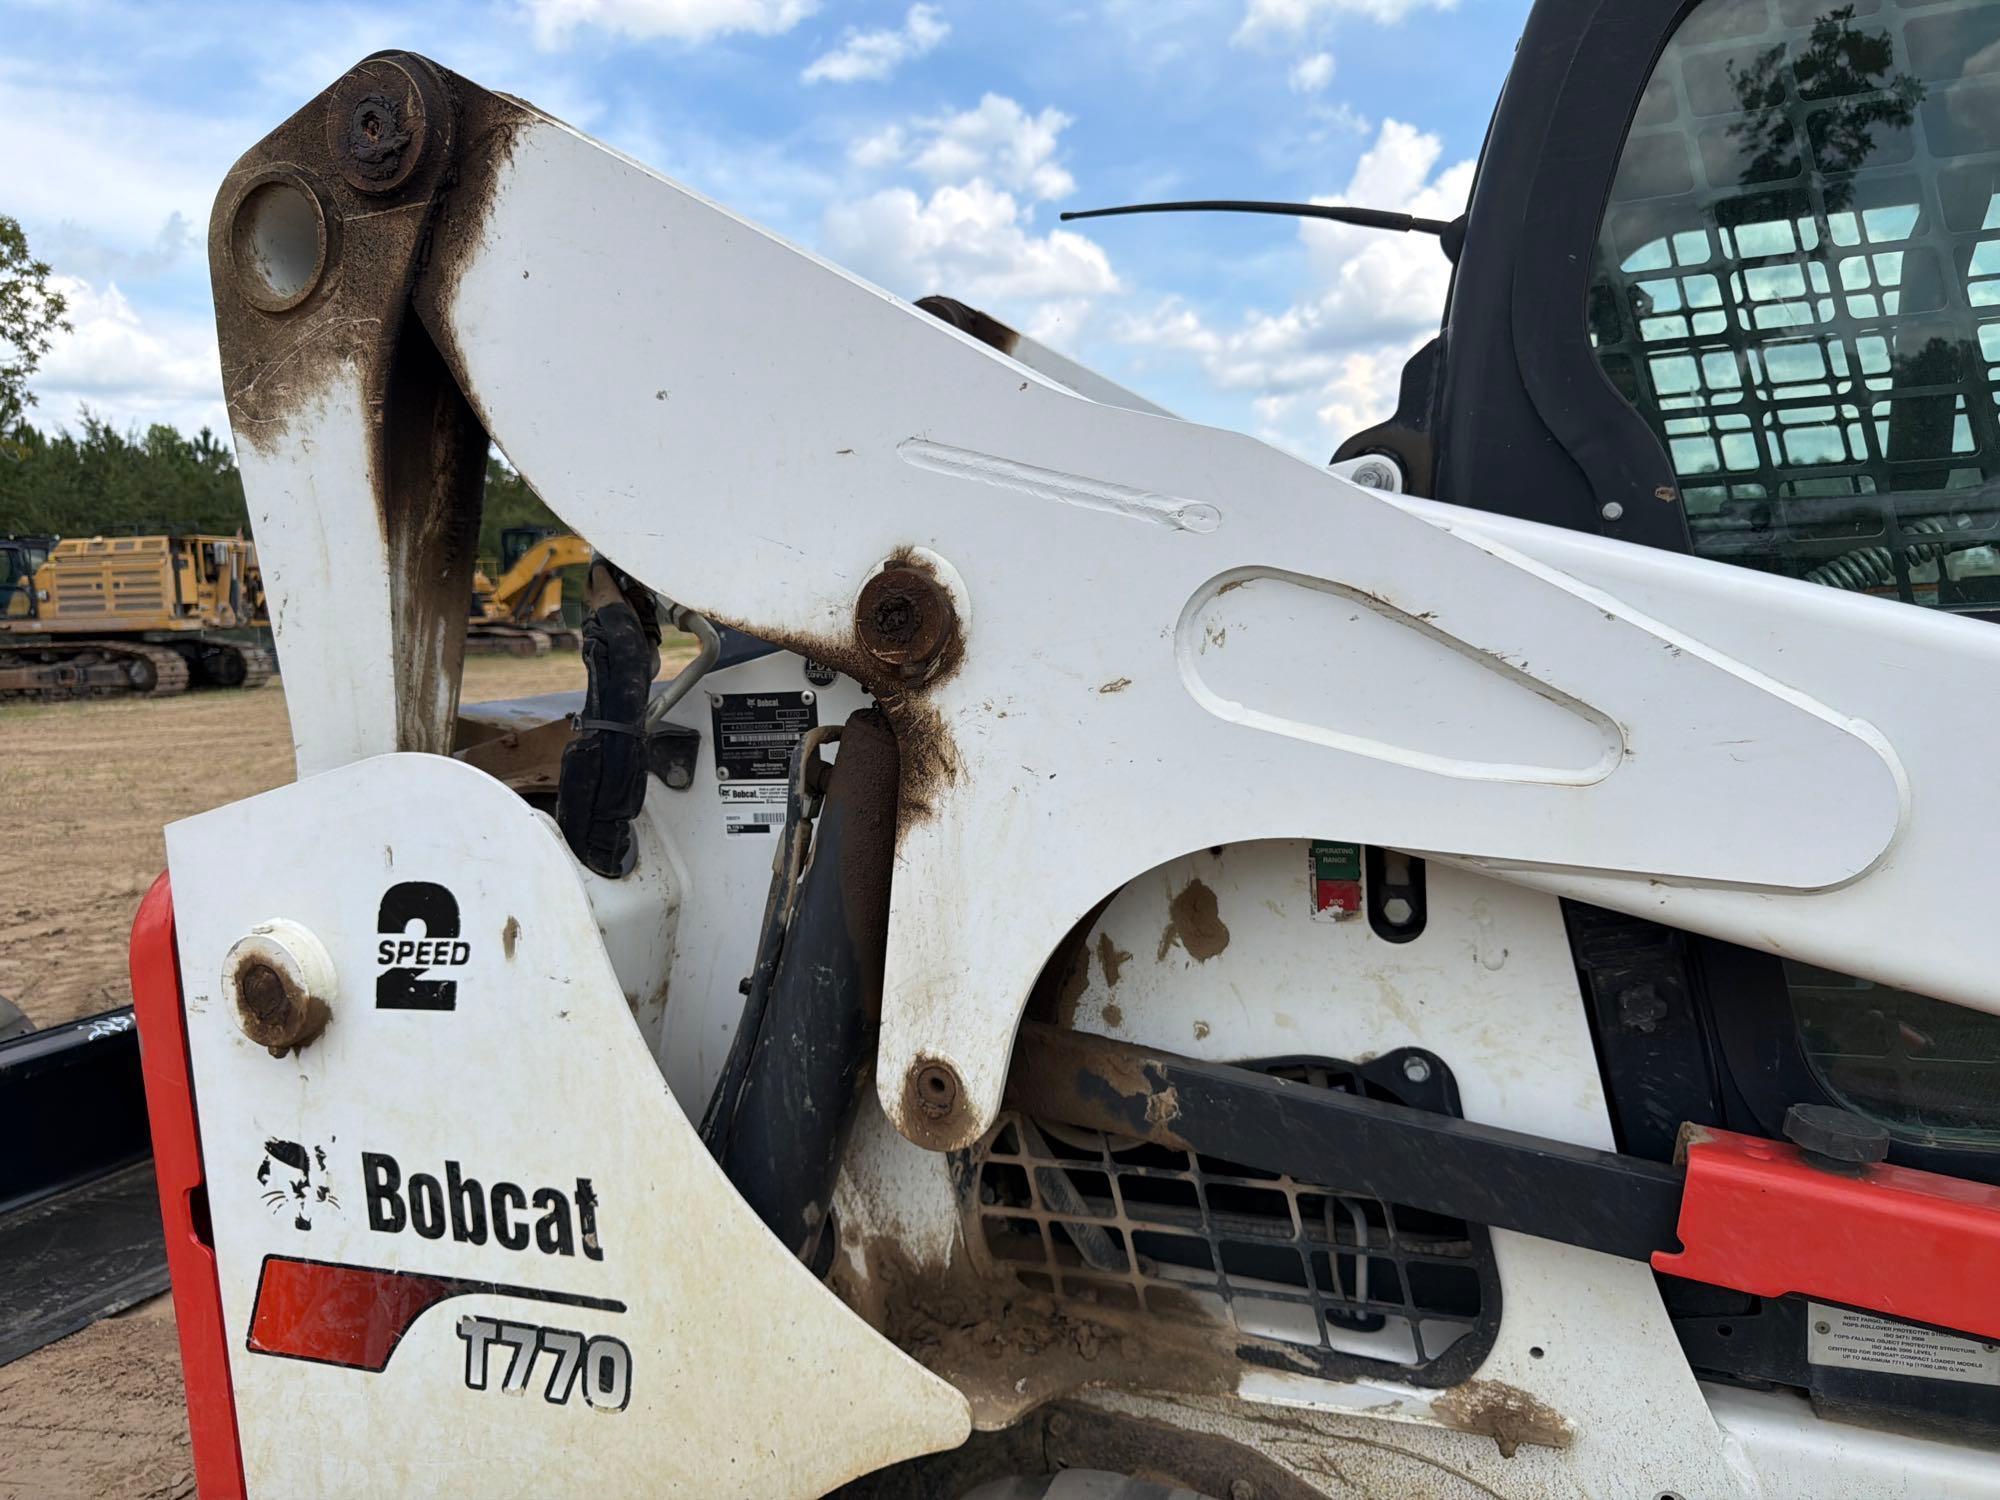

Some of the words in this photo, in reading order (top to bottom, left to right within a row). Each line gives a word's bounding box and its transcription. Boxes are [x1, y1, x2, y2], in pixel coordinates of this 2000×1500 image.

[732, 790, 757, 798] Bobcat
[377, 940, 471, 965] SPEED
[361, 1151, 604, 1261] Bobcat
[1893, 1328, 1930, 1336] PROTECTIVE
[1828, 1345, 1858, 1354] CERTIFIED
[1900, 1354, 1930, 1362] COMPACT
[1931, 1357, 1956, 1365] LOADER
[1957, 1361, 1983, 1369] MODELS
[1876, 1338, 1900, 1346] OBJECT
[1901, 1341, 1939, 1350] PROTECTIVE
[1940, 1346, 1976, 1354] STRUCTURE
[456, 1314, 632, 1412] T770
